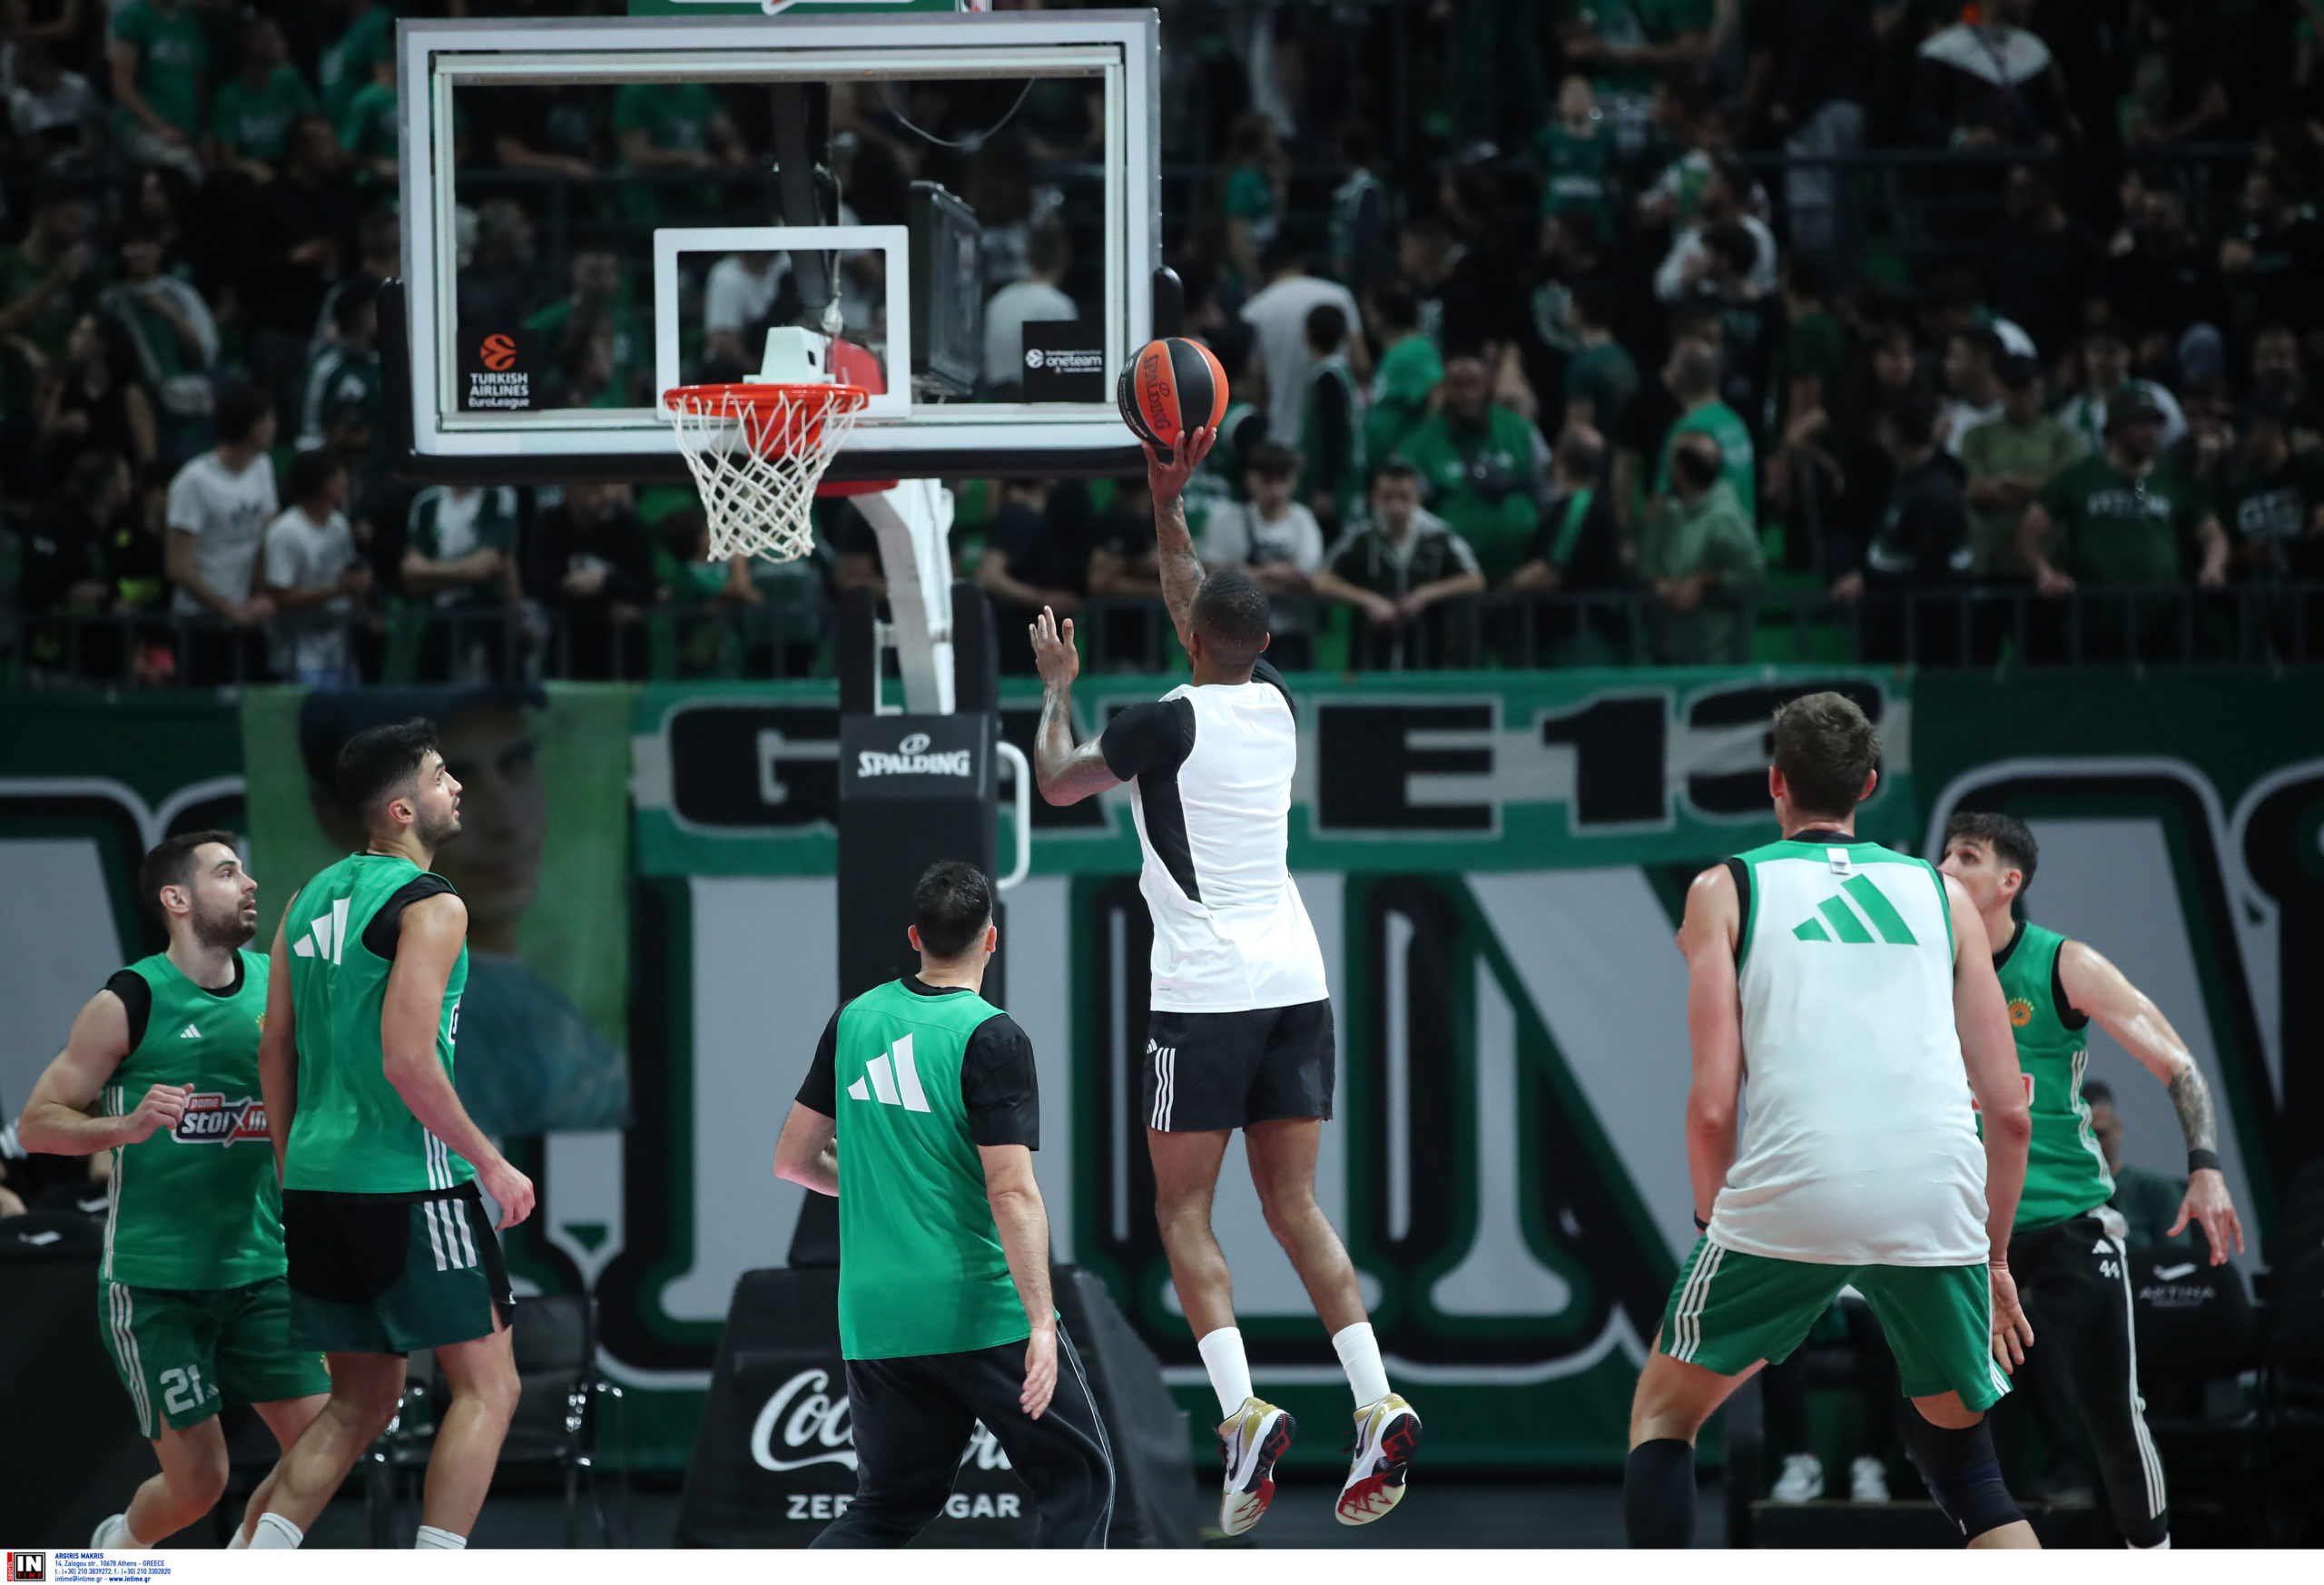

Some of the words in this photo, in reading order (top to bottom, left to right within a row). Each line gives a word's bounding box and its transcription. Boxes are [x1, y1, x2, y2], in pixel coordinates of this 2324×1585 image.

[469, 372, 528, 385] TURKISH
[469, 384, 529, 397] AIRLINES
[1143, 354, 1172, 430] SPALDING
[857, 750, 970, 778] SPALDING
[2099, 1259, 2121, 1280] 44
[160, 1364, 205, 1415] 21
[945, 1494, 1021, 1519] GAR
